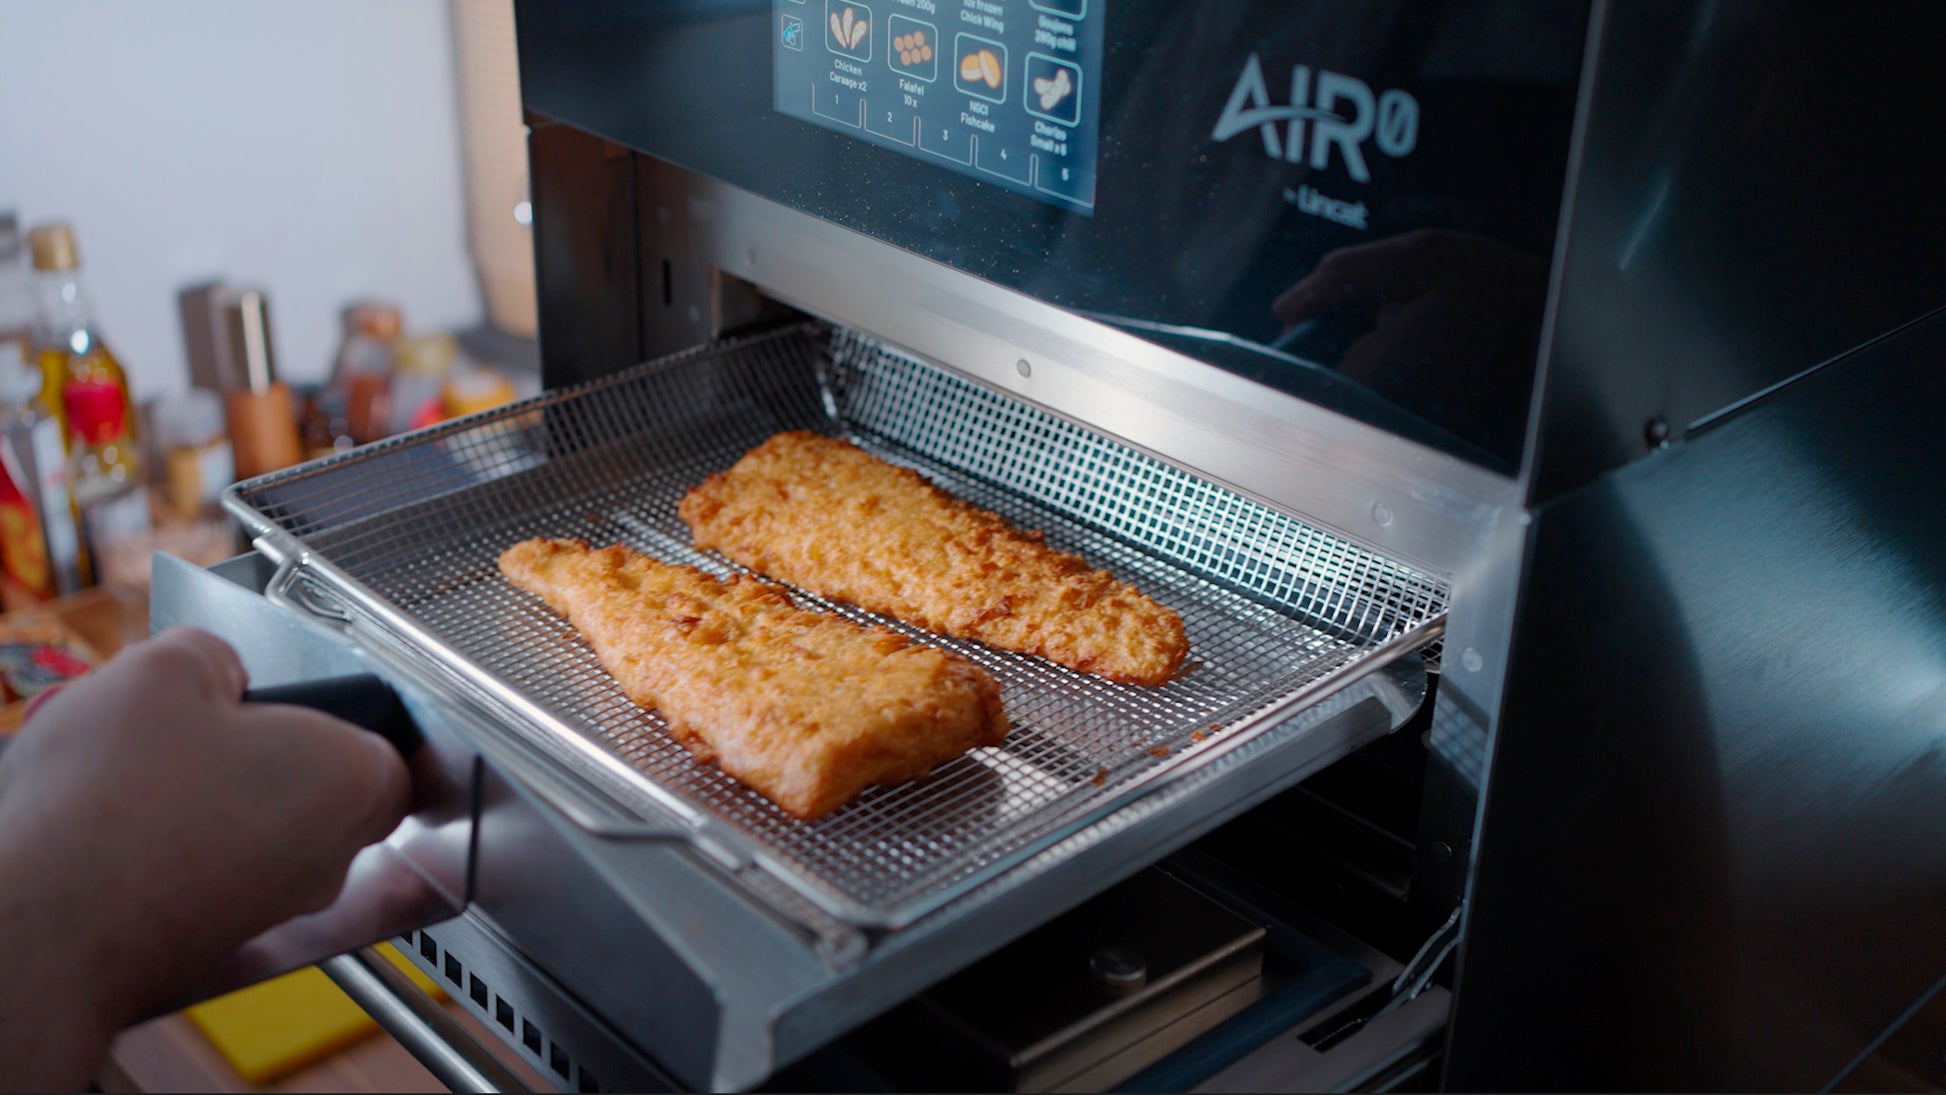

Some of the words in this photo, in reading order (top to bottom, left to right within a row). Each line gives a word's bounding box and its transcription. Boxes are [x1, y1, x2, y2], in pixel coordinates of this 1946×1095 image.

[960, 9, 982, 26] Chick
[983, 15, 1005, 34] Wing
[834, 59, 862, 76] Chicken
[829, 71, 857, 89] Caraage
[858, 81, 867, 92] x2
[899, 78, 925, 96] Falafel
[904, 94, 912, 106] 10
[887, 111, 893, 124] 2
[960, 112, 995, 133] Fishcake
[942, 129, 949, 141] 3
[1000, 148, 1007, 160] 4
